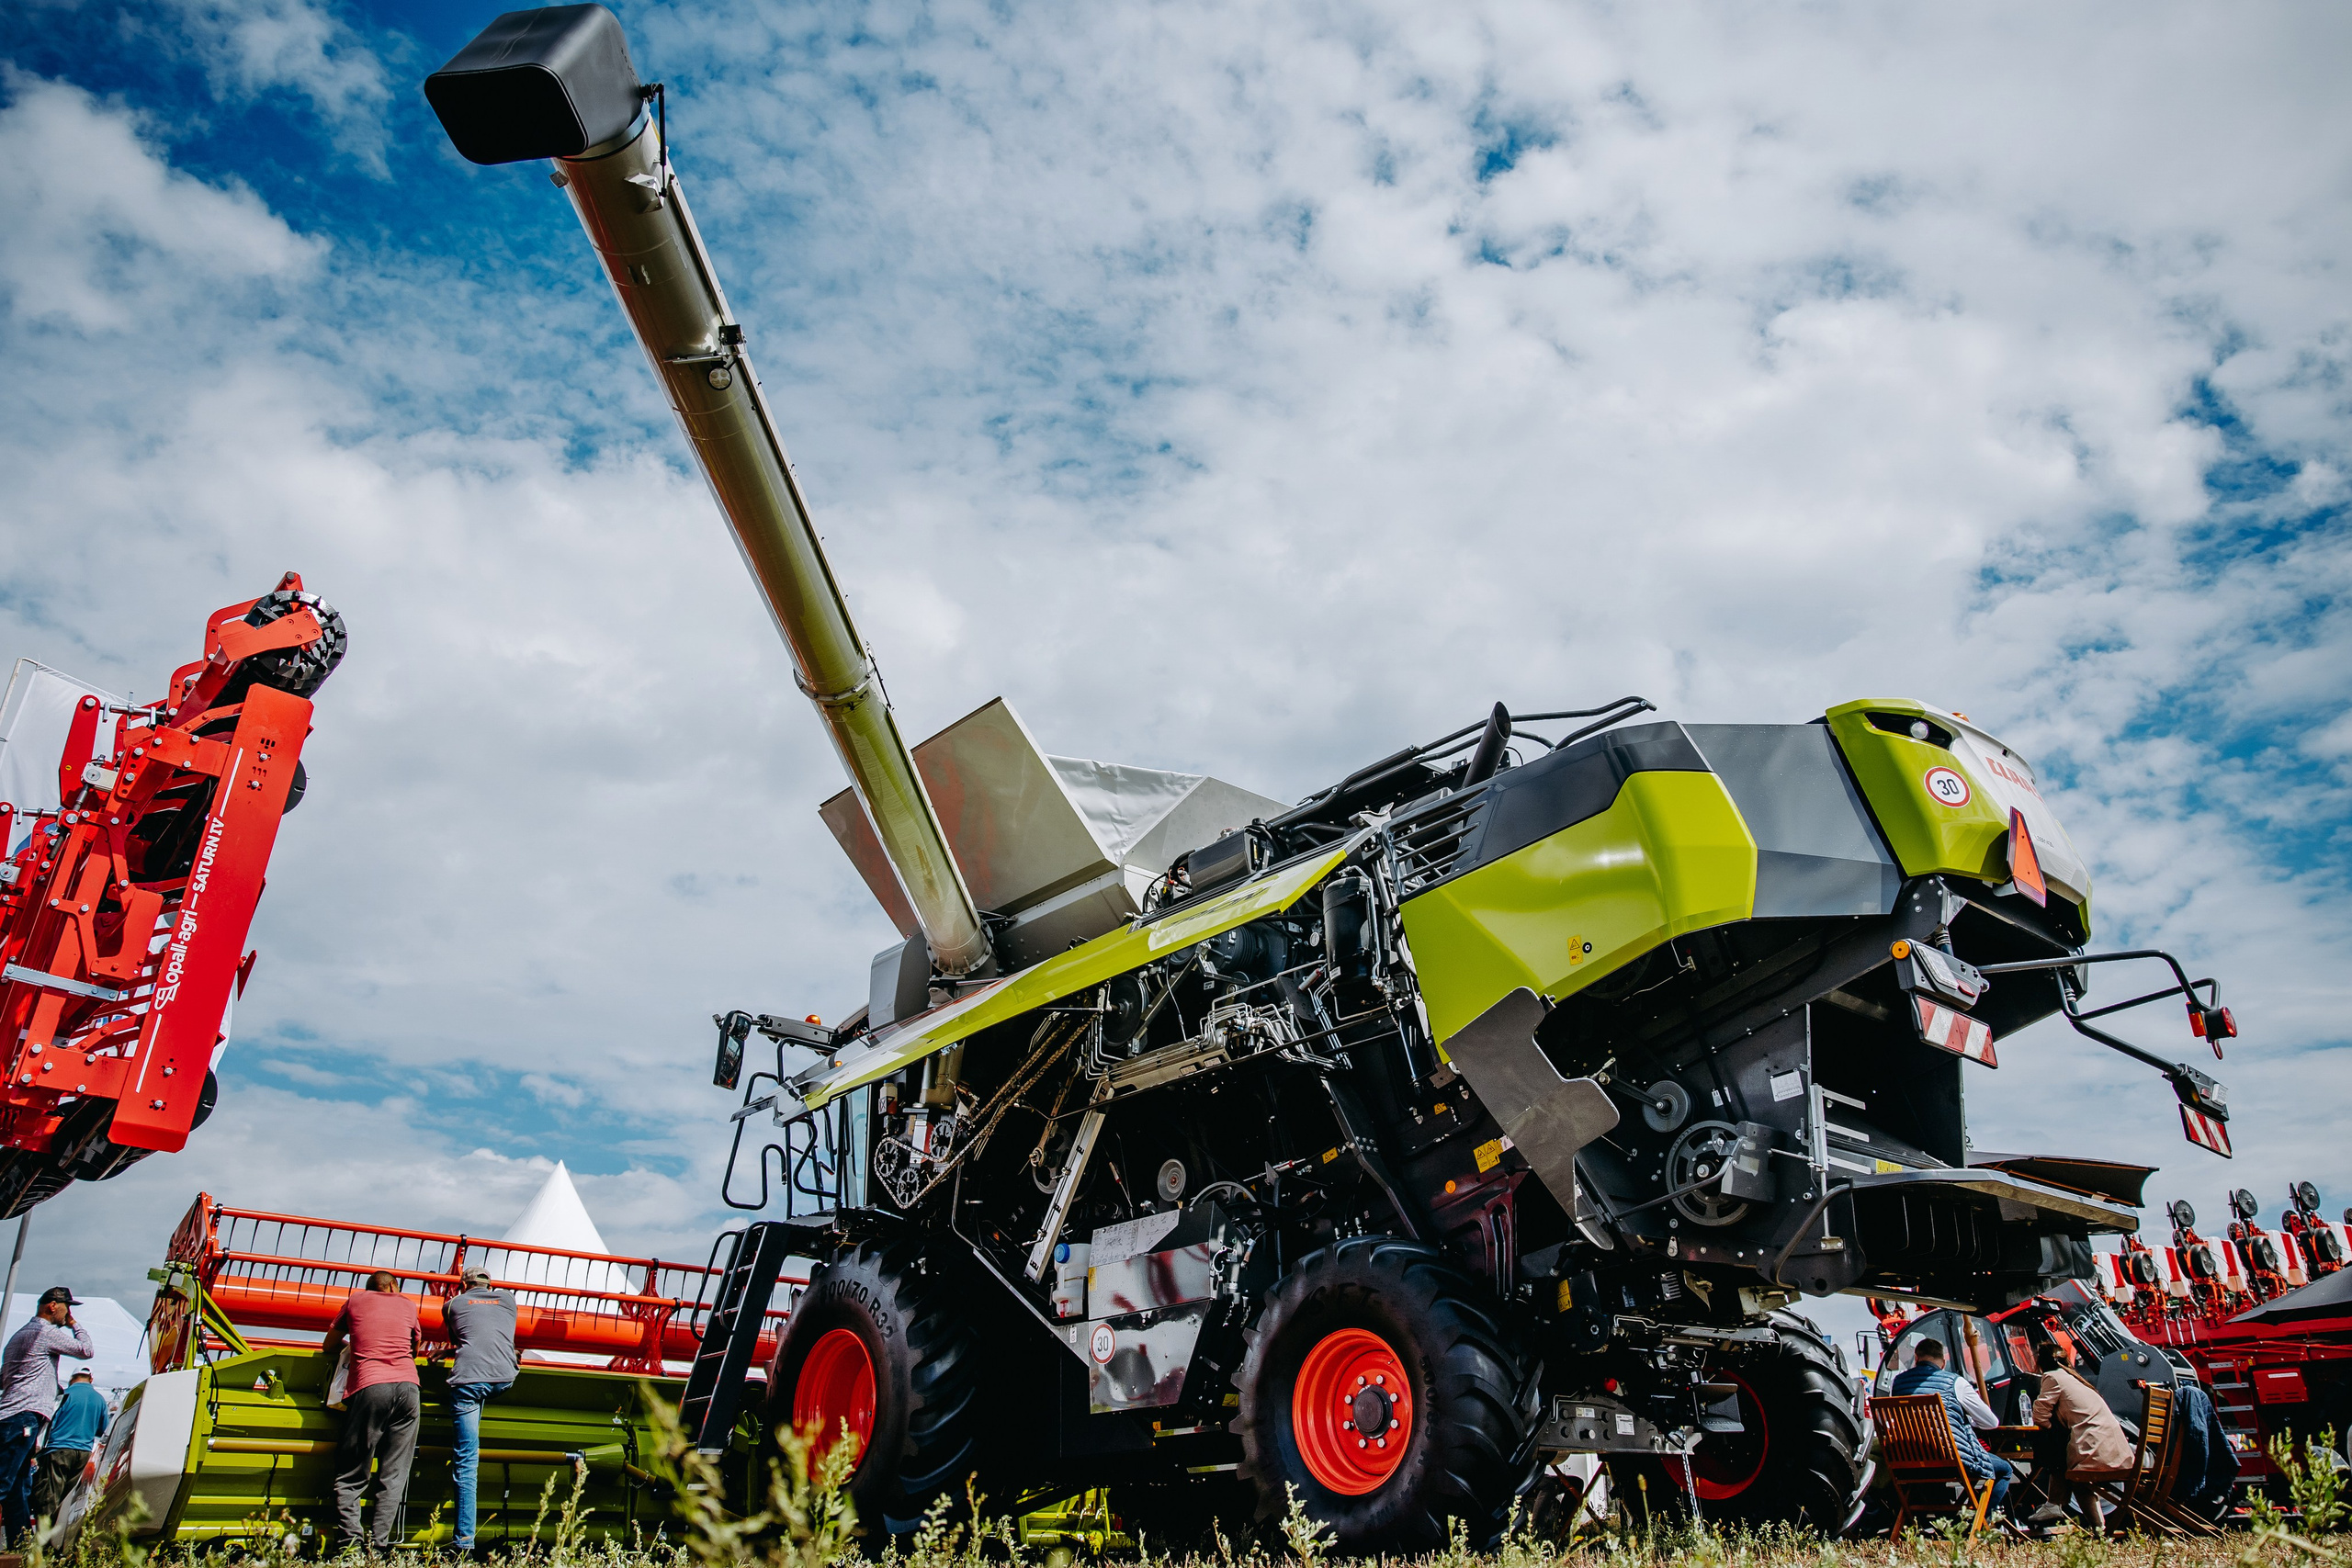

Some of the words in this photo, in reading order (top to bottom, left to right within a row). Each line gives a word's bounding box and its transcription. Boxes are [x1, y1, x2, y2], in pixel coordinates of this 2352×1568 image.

[1937, 778, 1960, 795] 30
[192, 837, 220, 894] SATURN
[209, 817, 225, 837] IV
[1097, 1336, 1108, 1352] 30
